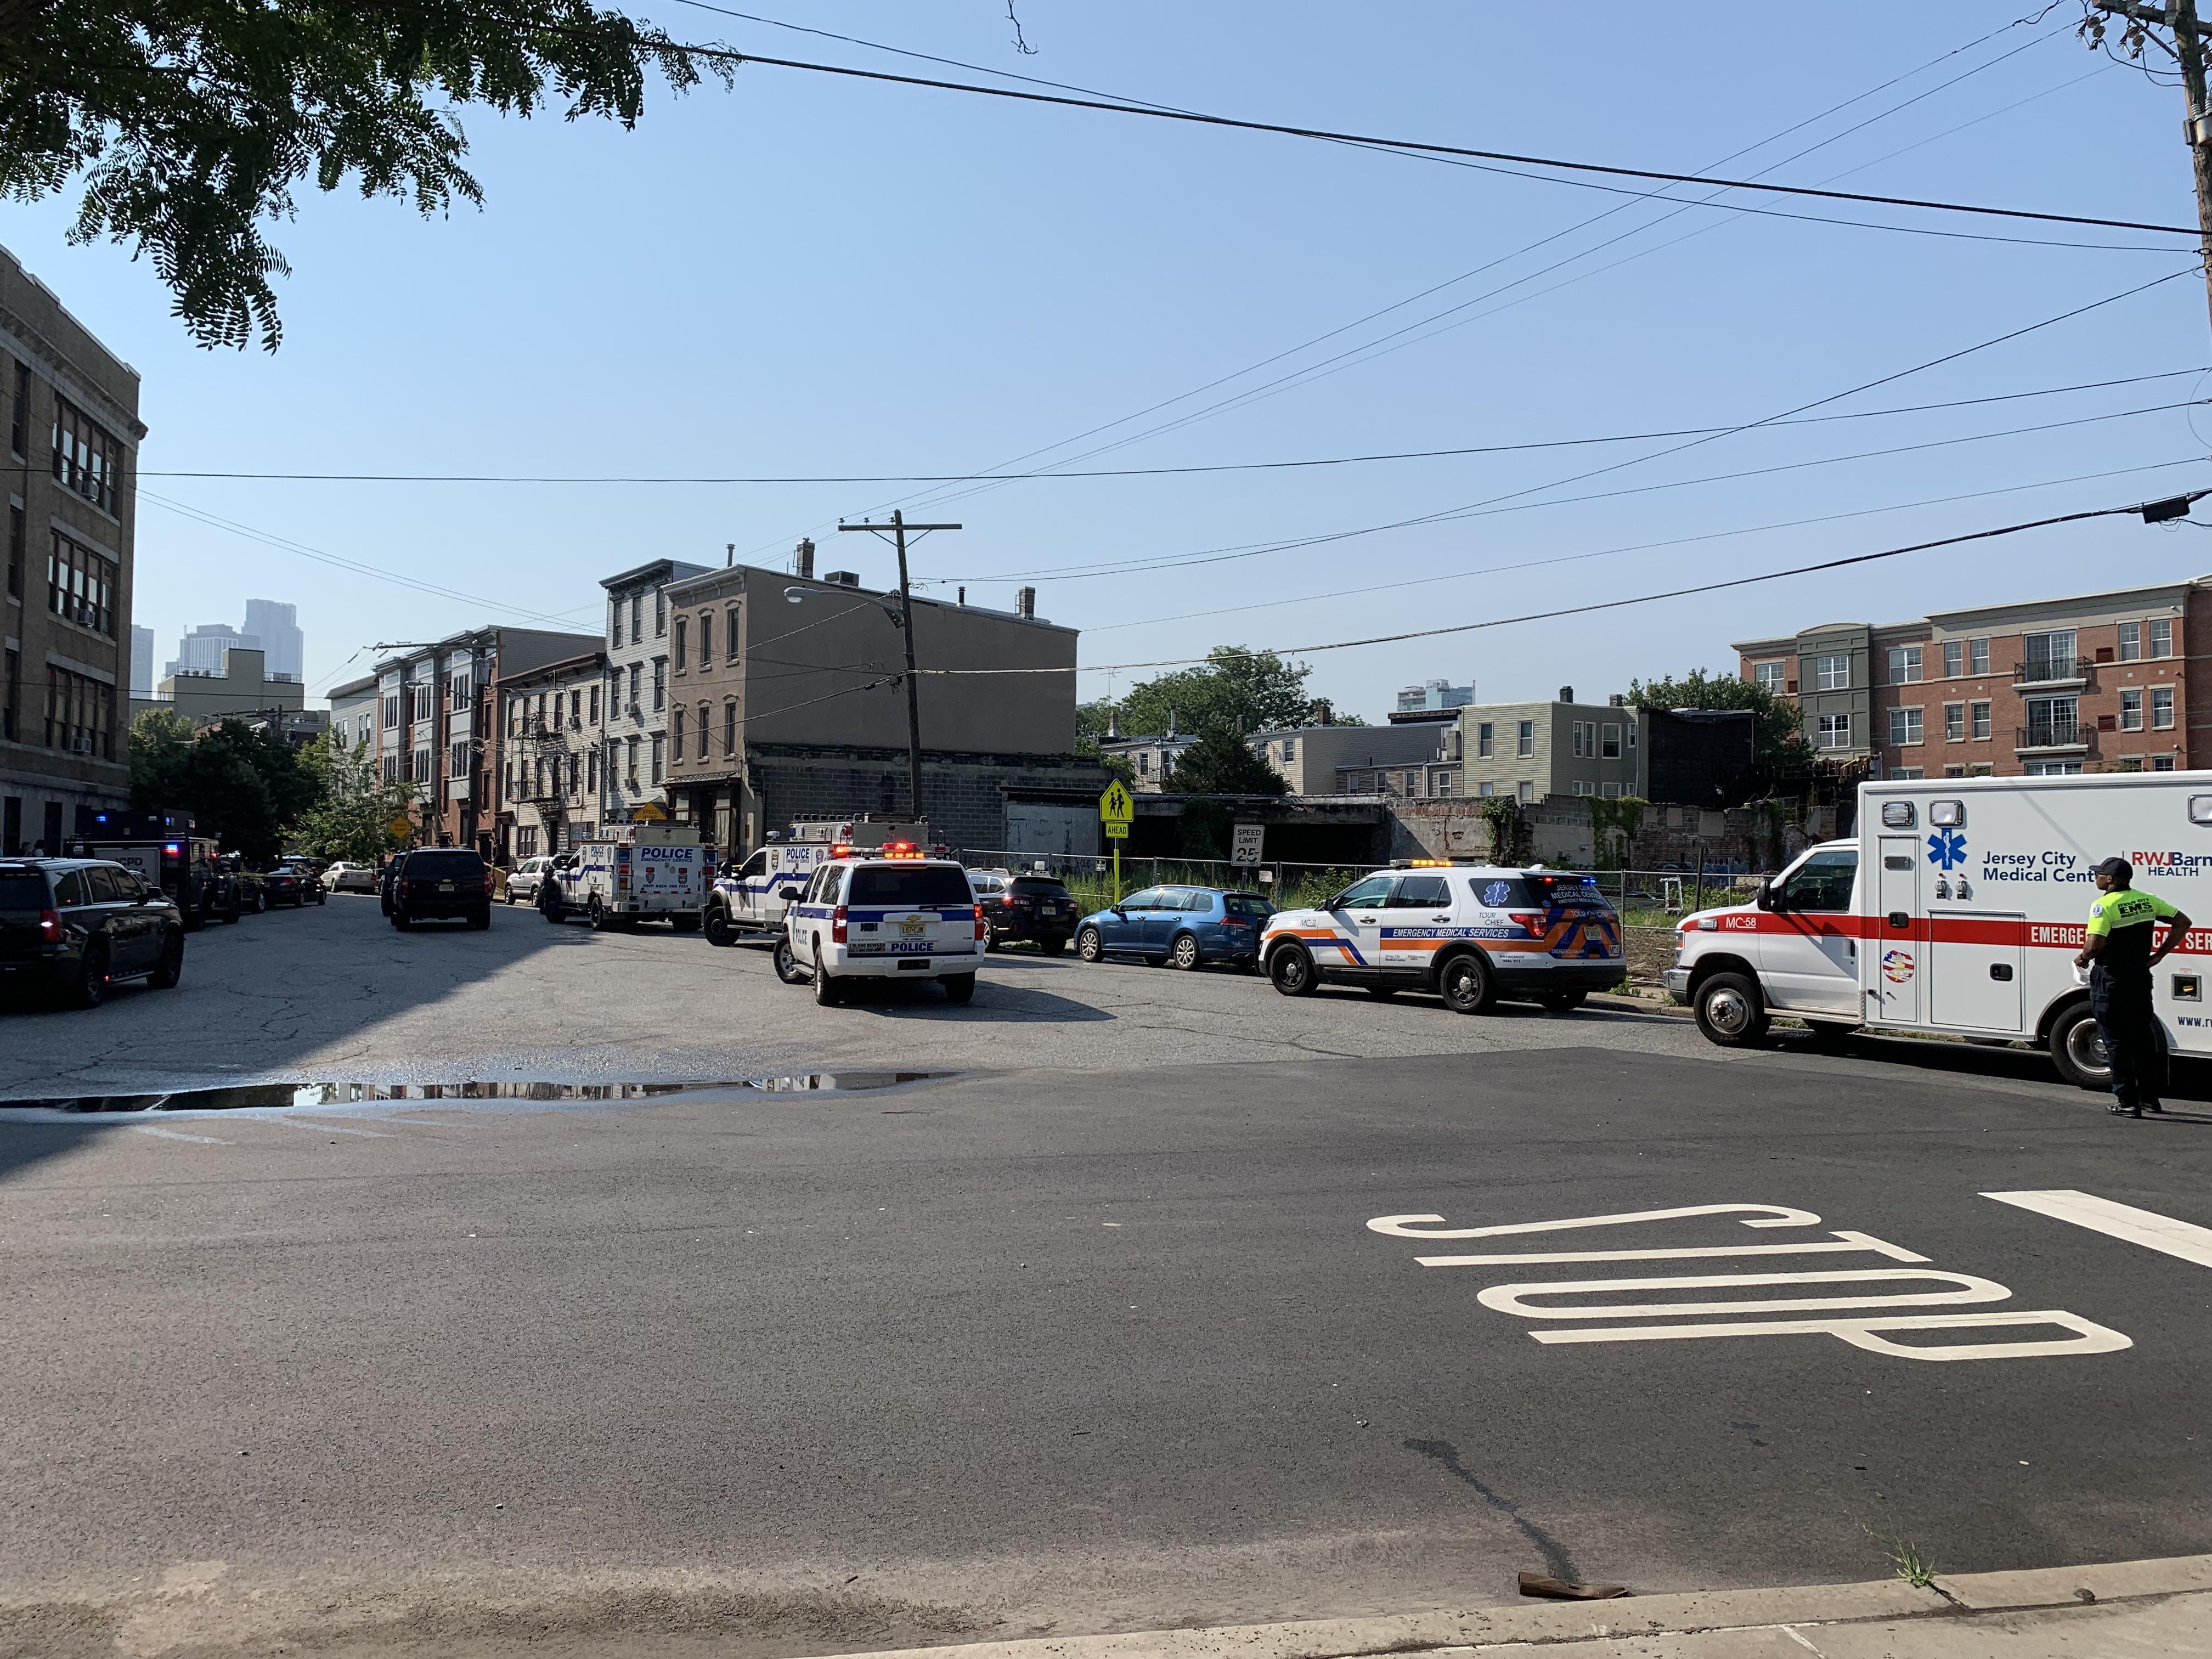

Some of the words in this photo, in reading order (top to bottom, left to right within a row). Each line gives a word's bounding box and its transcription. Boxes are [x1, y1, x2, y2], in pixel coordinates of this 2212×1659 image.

[1108, 826, 1127, 834] AHEAD
[641, 848, 693, 859] POLICE
[786, 848, 809, 859] POLICE
[1236, 847, 1258, 862] 25
[1983, 851, 2036, 867] Jersey
[2042, 851, 2076, 868] City
[2132, 851, 2212, 866] RWJBarn
[1983, 868, 2047, 882] Medical
[2053, 868, 2095, 883] Cent
[2148, 867, 2199, 876] HEALTH
[1550, 891, 1581, 900] MEDICAL
[2119, 902, 2153, 914] EMS
[1726, 917, 1756, 929] MC-58
[795, 928, 807, 945] POLICE
[1392, 928, 1436, 938] EMERGENCY
[1436, 928, 1467, 937] MEDICAL
[1468, 928, 1509, 938] SERVICES
[2031, 926, 2087, 945] EMERGE
[891, 943, 934, 952] POLICE
[1367, 1204, 2134, 1362] STOP
